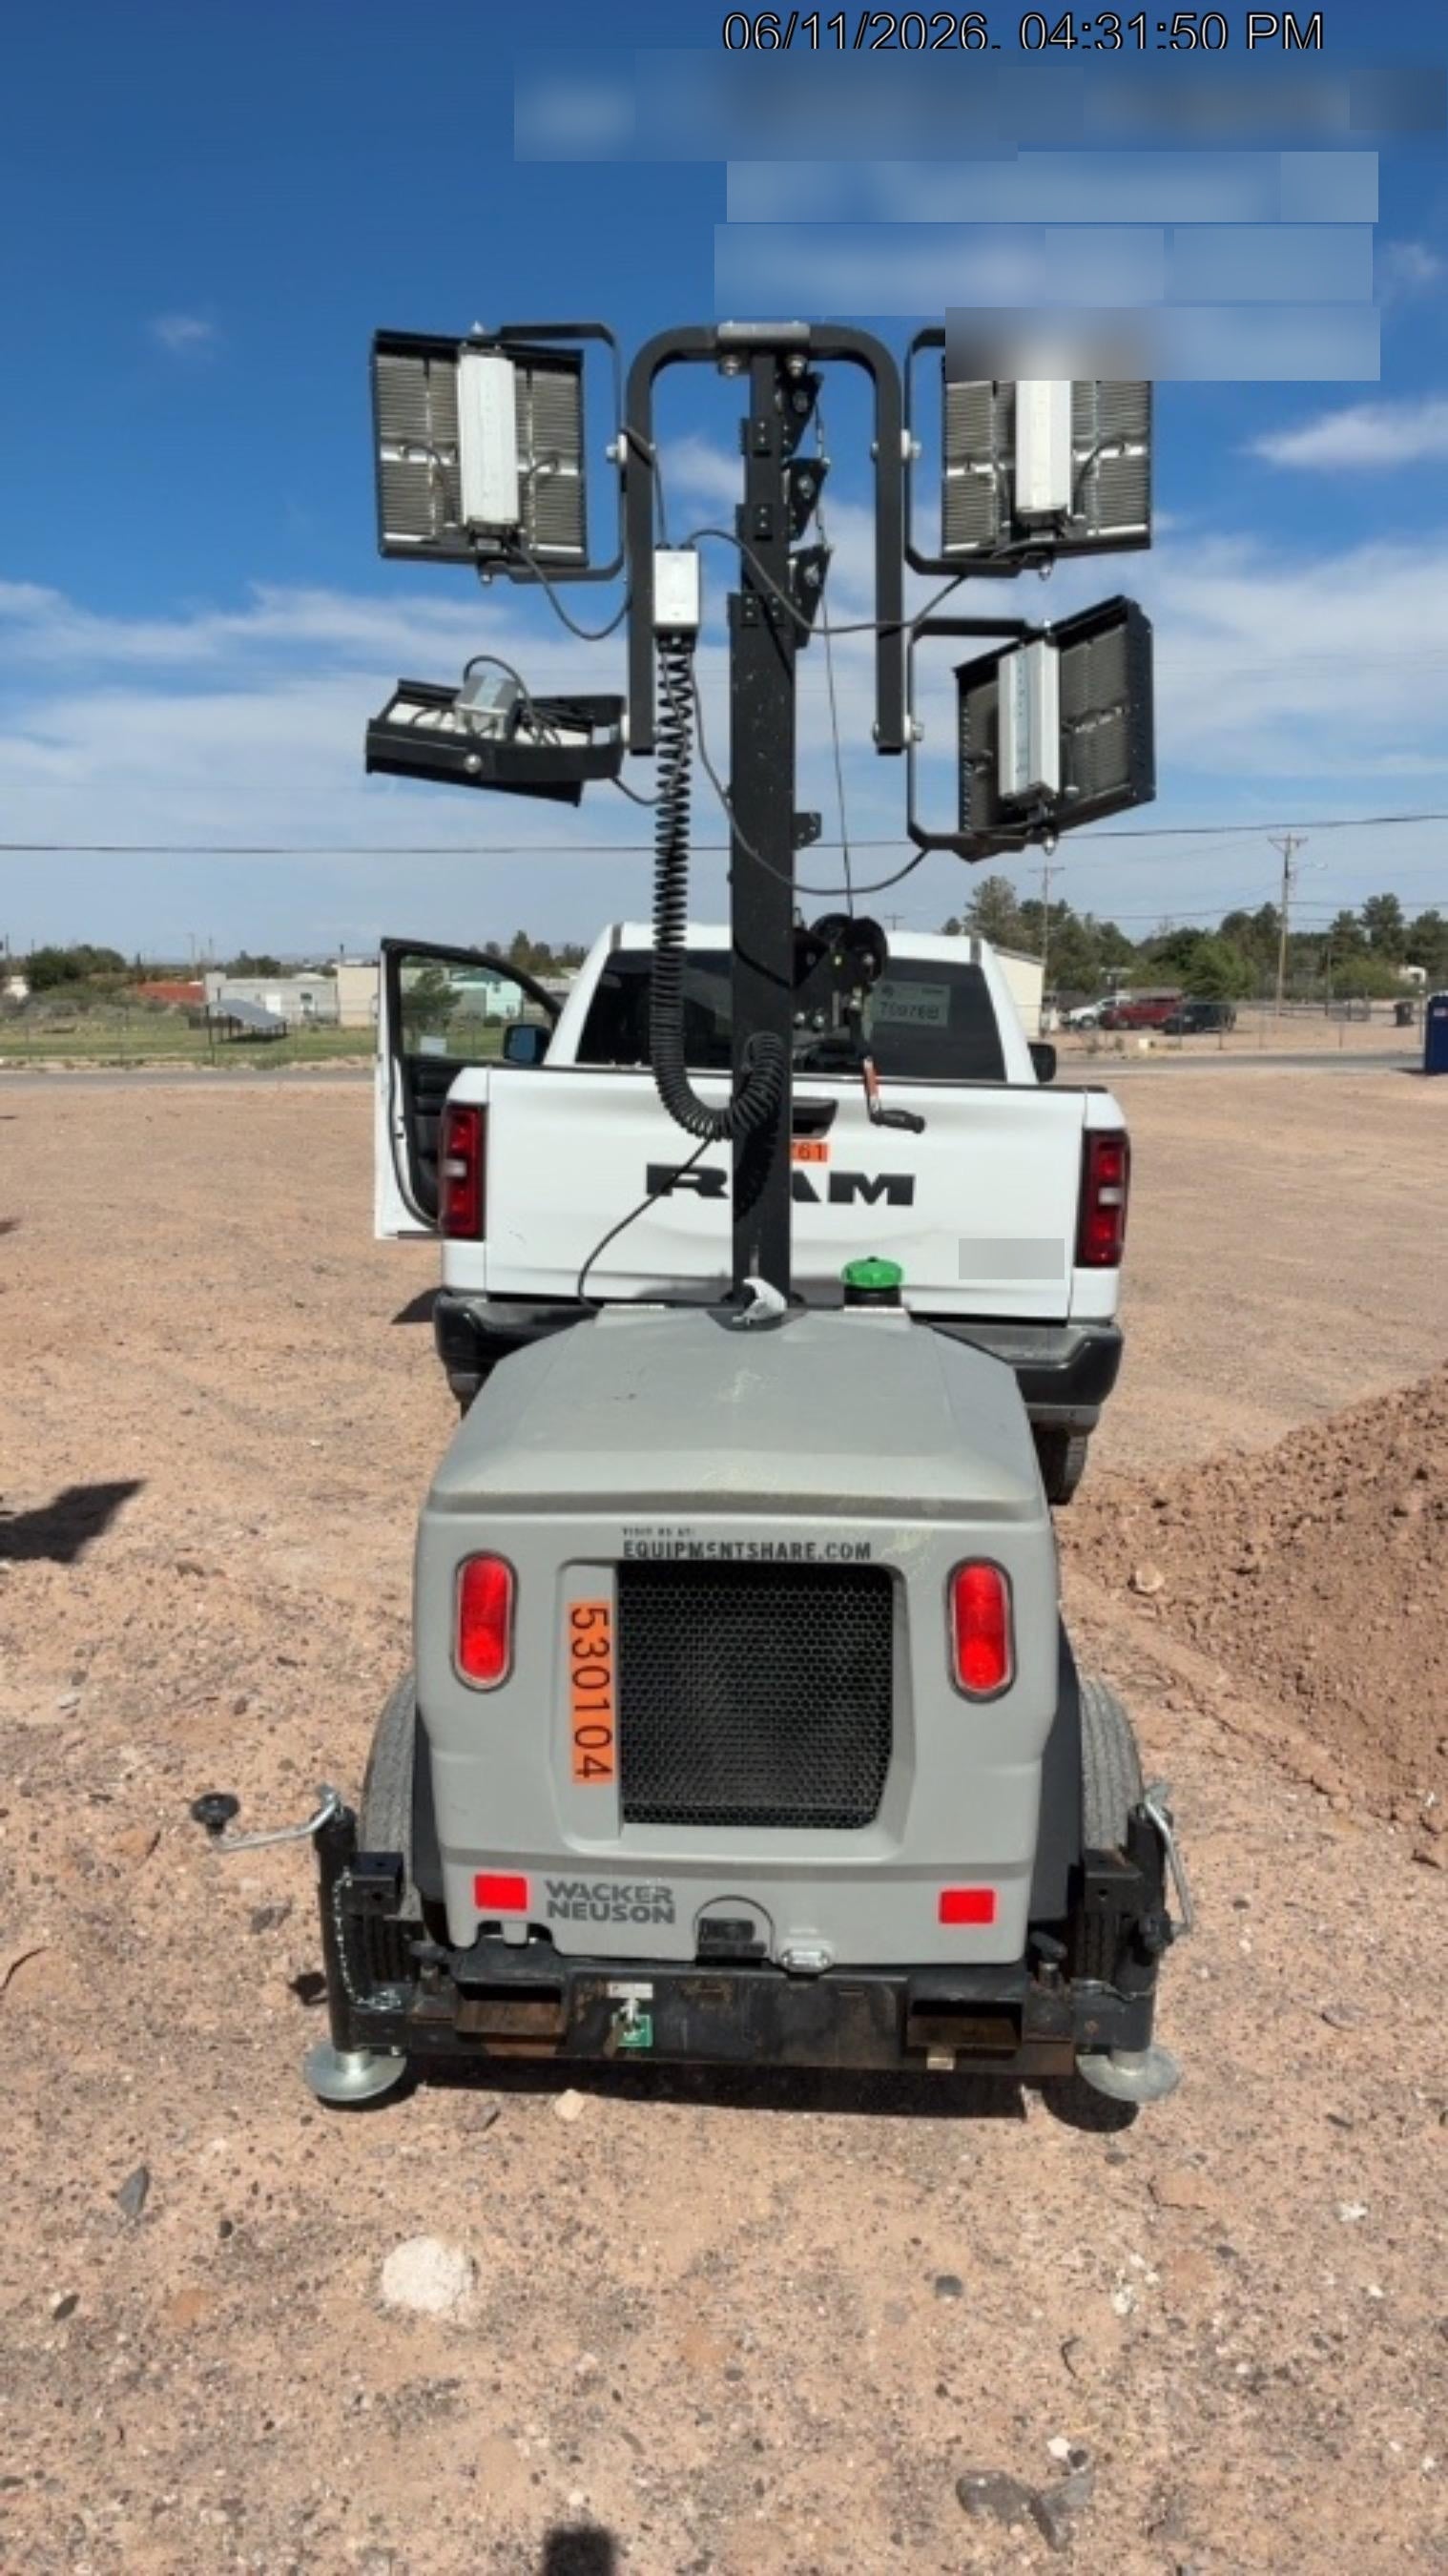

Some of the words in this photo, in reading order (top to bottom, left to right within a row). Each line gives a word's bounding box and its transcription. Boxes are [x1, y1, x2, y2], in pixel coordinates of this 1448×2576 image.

[570, 1607, 613, 1779] 530104
[544, 1880, 674, 1904] WACKER
[547, 1900, 675, 1924] NEUSON
